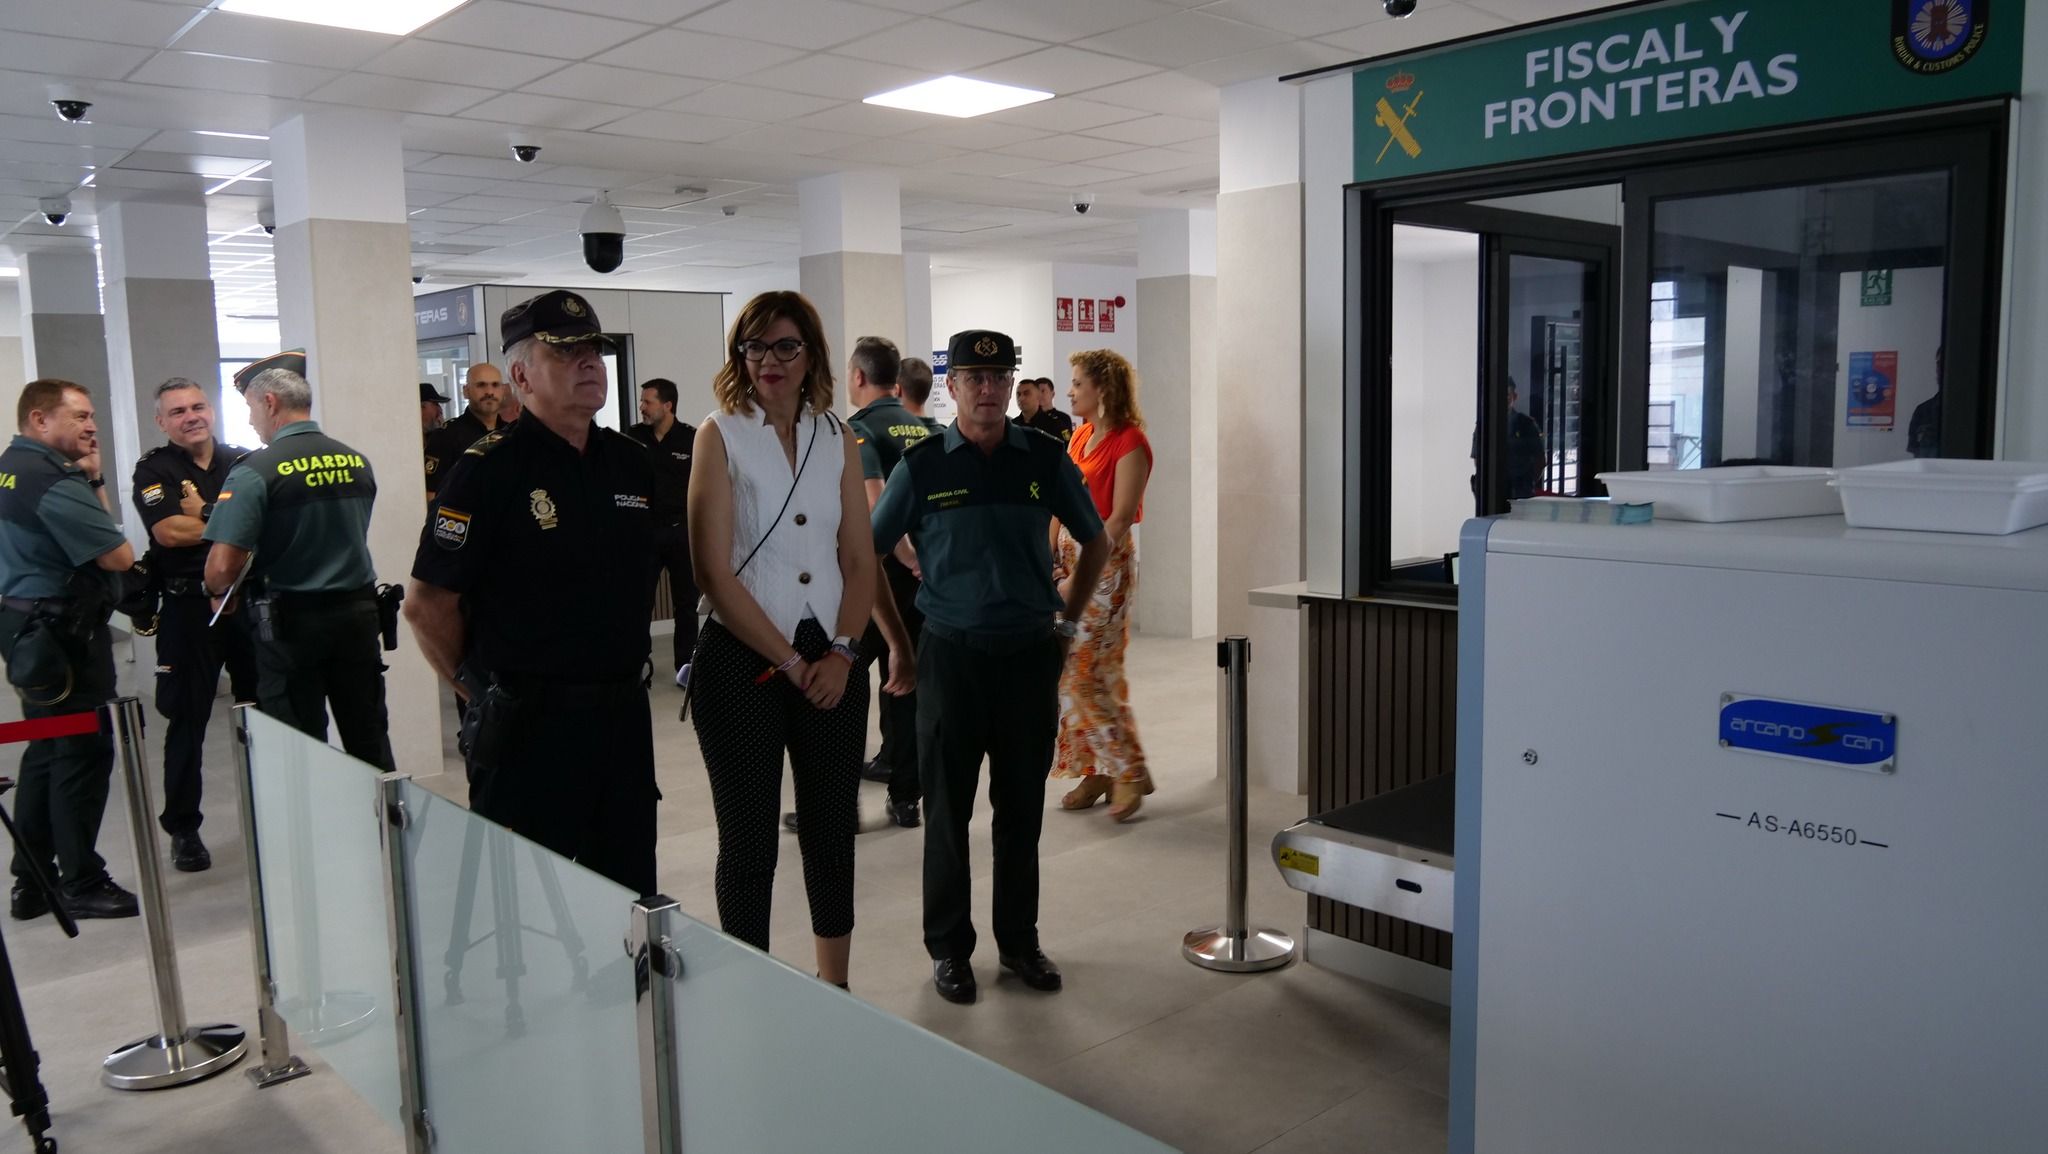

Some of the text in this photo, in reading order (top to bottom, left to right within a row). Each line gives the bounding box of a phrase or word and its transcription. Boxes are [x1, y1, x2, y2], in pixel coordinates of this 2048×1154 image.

[1525, 10, 1749, 89] FISCAL Y
[1894, 35, 1915, 65] BORDER
[1922, 52, 1965, 72] CUSTOMS
[1963, 23, 1984, 54] POLICE
[1484, 53, 1798, 139] FRONTERAS
[277, 454, 365, 475] GUARDIA
[305, 469, 354, 487] CIVIL
[927, 491, 953, 501] GUARDIA
[1730, 717, 1805, 740] arcano
[1747, 811, 1857, 846] AS-A6550
